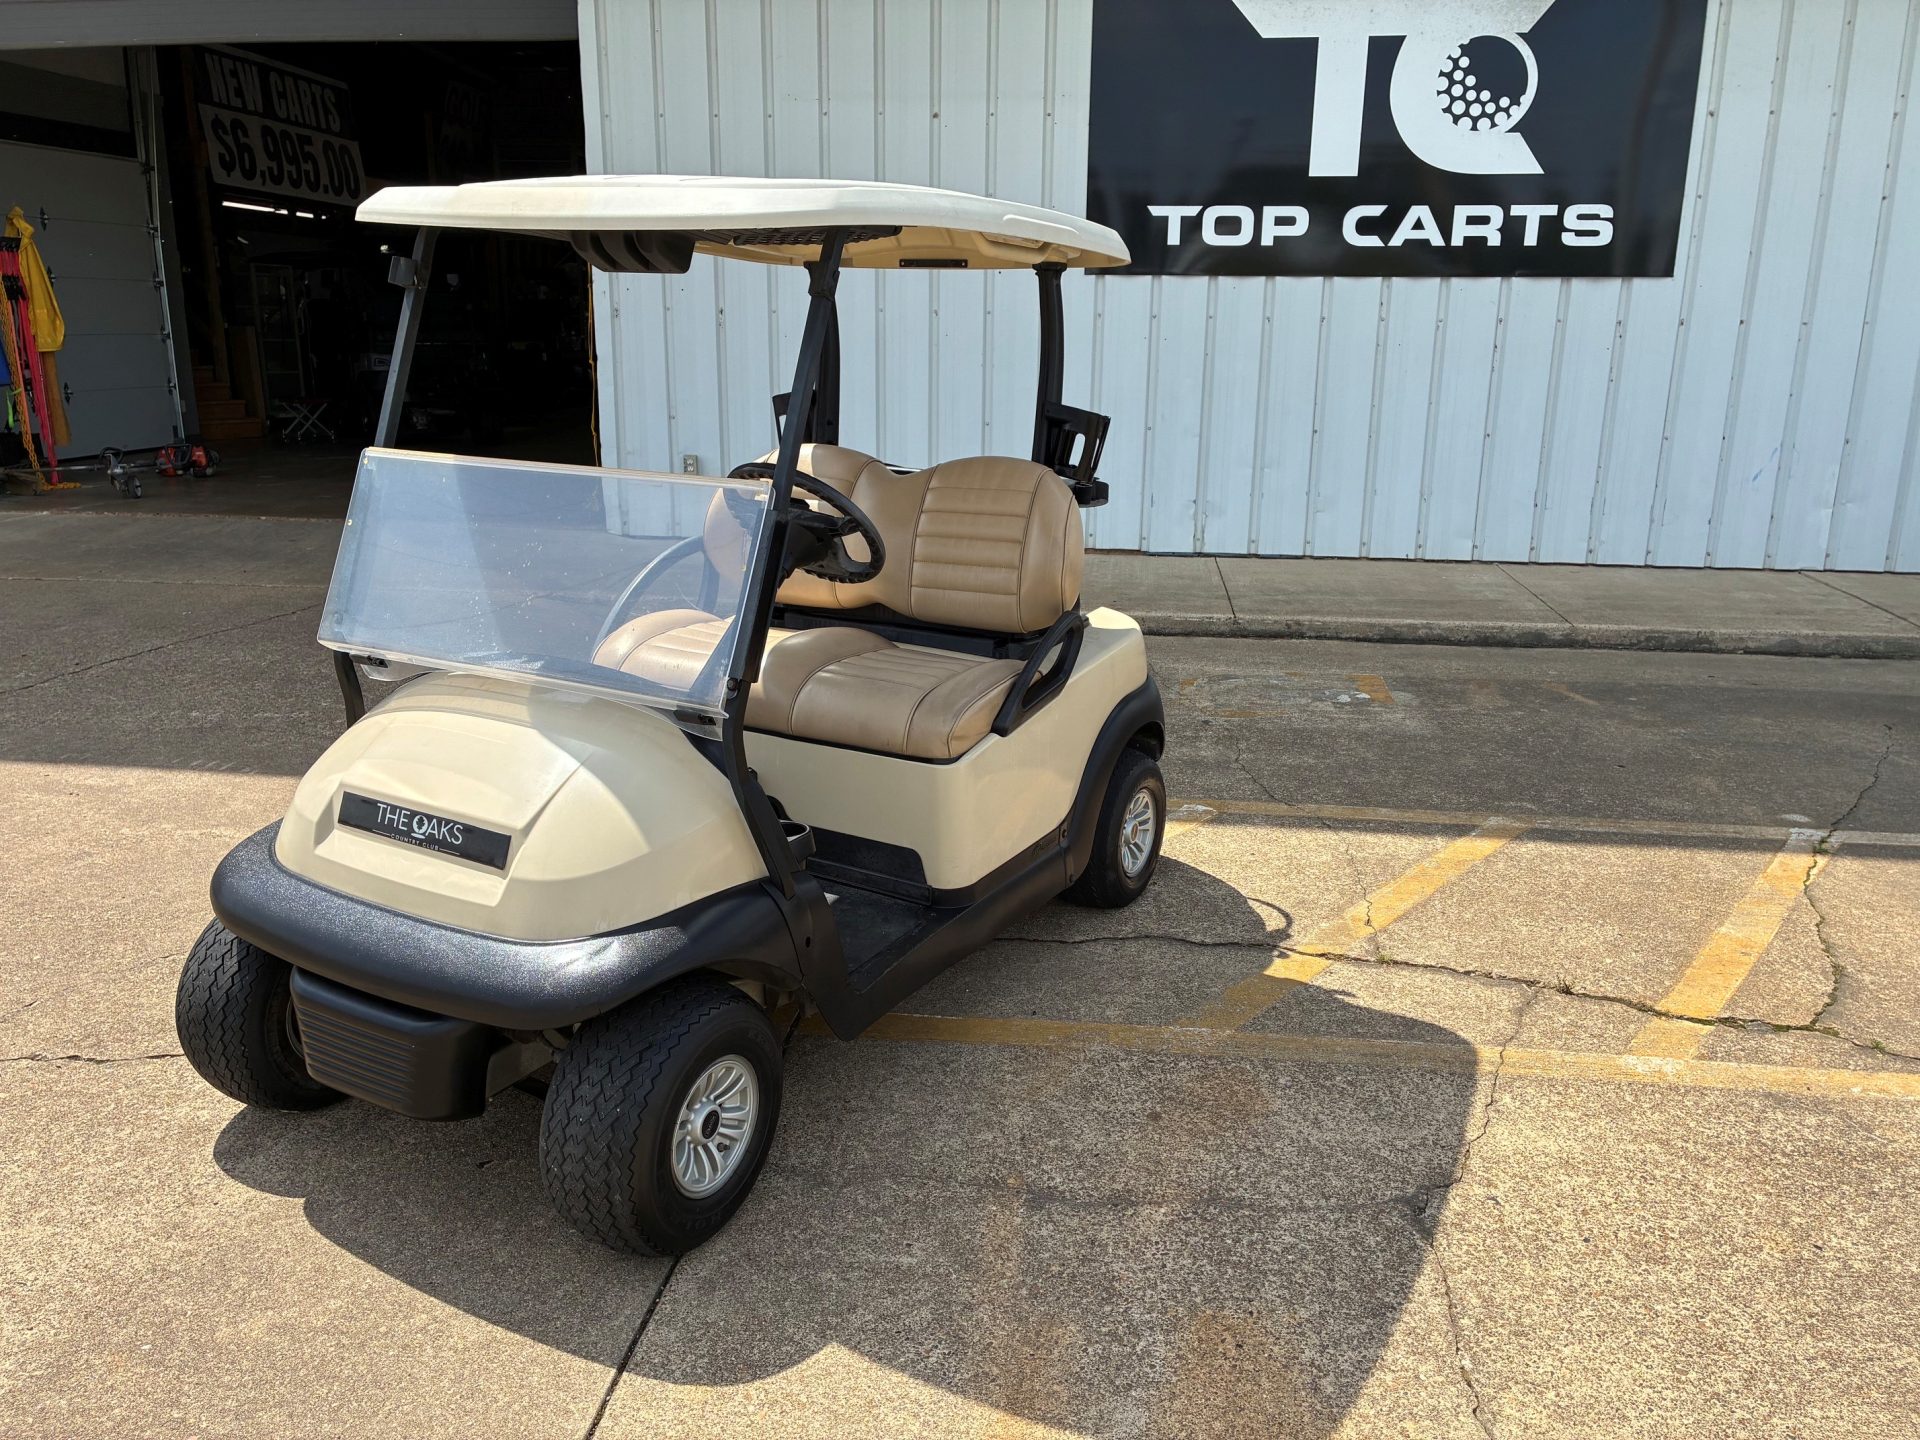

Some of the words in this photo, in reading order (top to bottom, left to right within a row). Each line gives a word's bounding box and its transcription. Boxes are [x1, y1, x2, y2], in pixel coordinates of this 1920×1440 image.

[205, 53, 263, 114] NEW
[269, 71, 341, 133] CARTS
[210, 113, 361, 200] $6,995.00
[1147, 204, 1310, 247] TOP
[1342, 203, 1615, 248] CARTS
[376, 803, 411, 831] THE
[411, 814, 464, 845] OAKS
[390, 833, 420, 846] COUNTRY
[422, 842, 439, 851] CLUB
